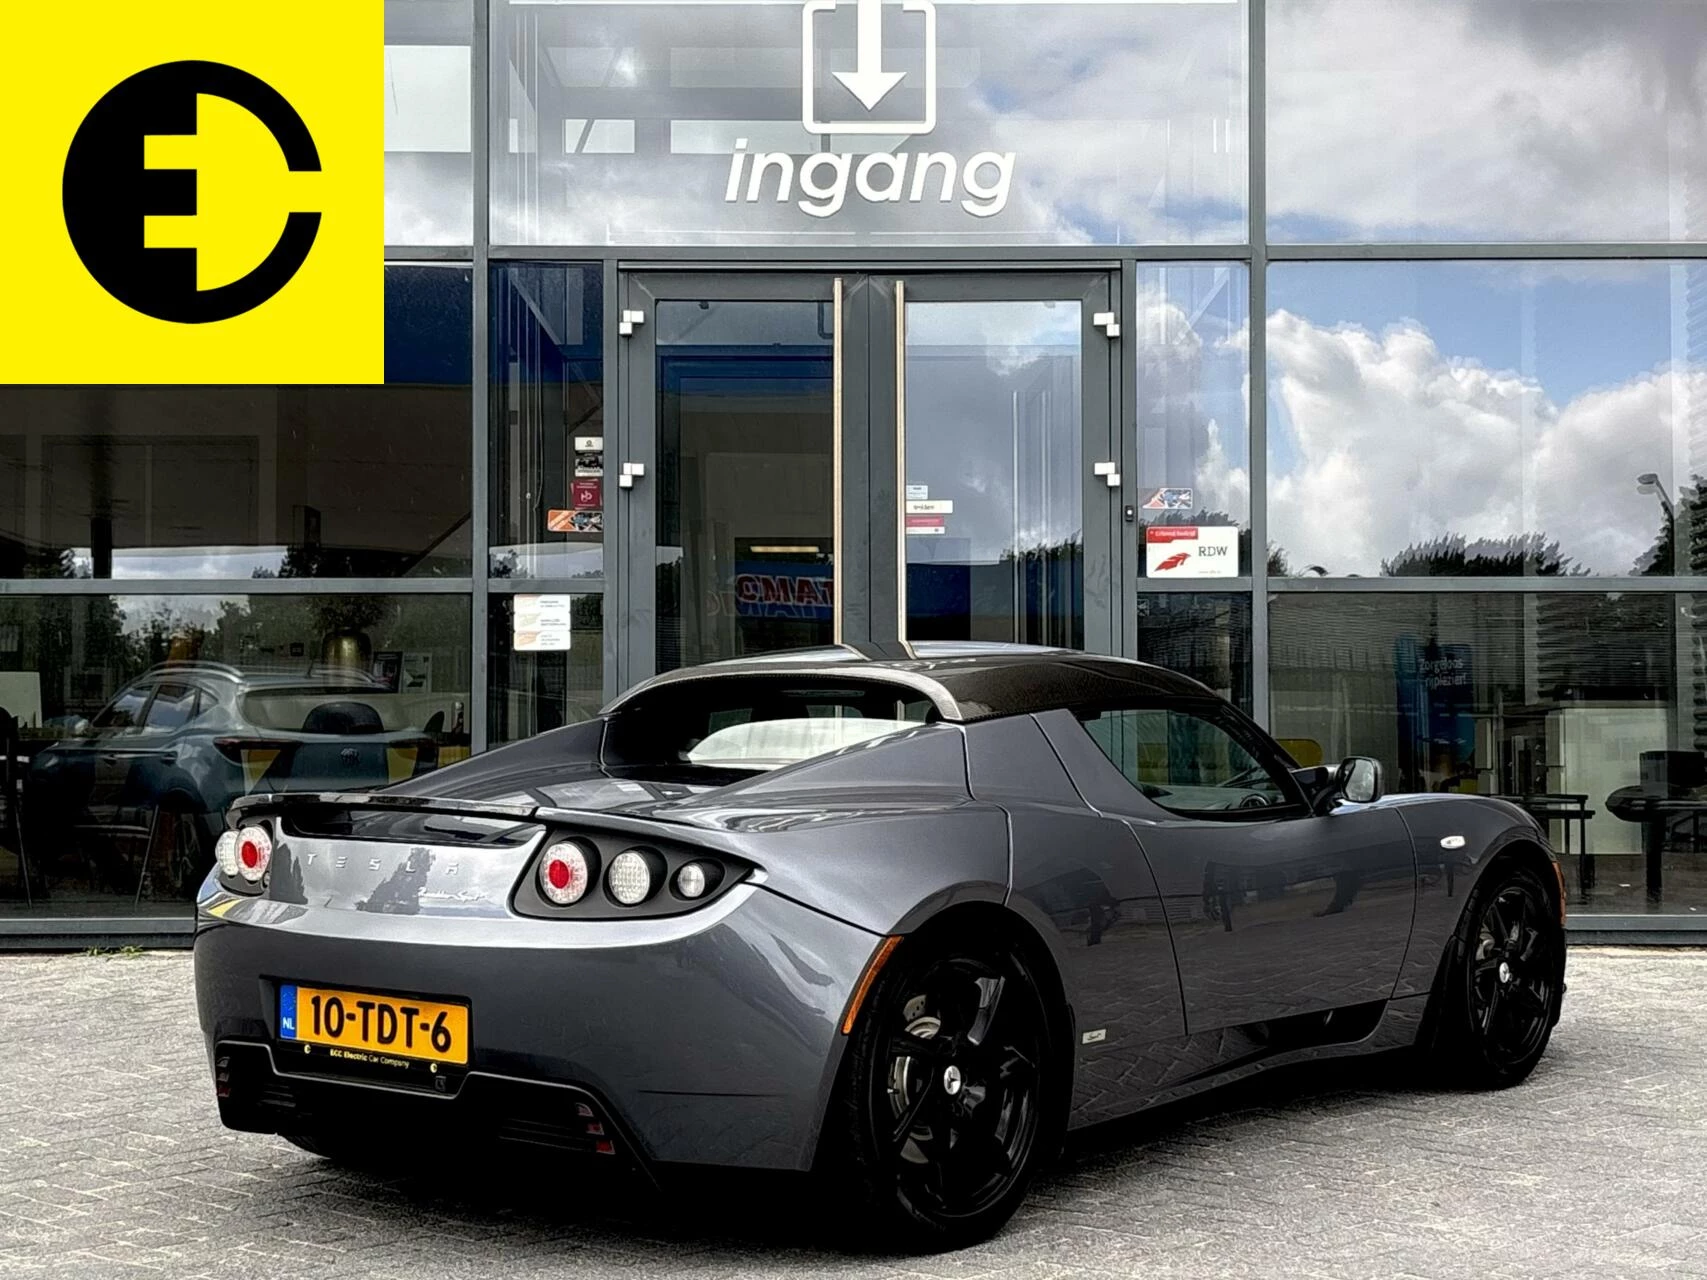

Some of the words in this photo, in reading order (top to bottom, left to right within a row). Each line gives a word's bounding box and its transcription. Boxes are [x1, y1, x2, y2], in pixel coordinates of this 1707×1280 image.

[725, 137, 1017, 218] ingang
[1198, 546, 1228, 557] RDW
[307, 854, 458, 875] TESLA
[282, 1015, 295, 1030] NL
[311, 995, 452, 1053] 10-TDT-6
[344, 1052, 367, 1061] Electric
[380, 1057, 409, 1069] Company
